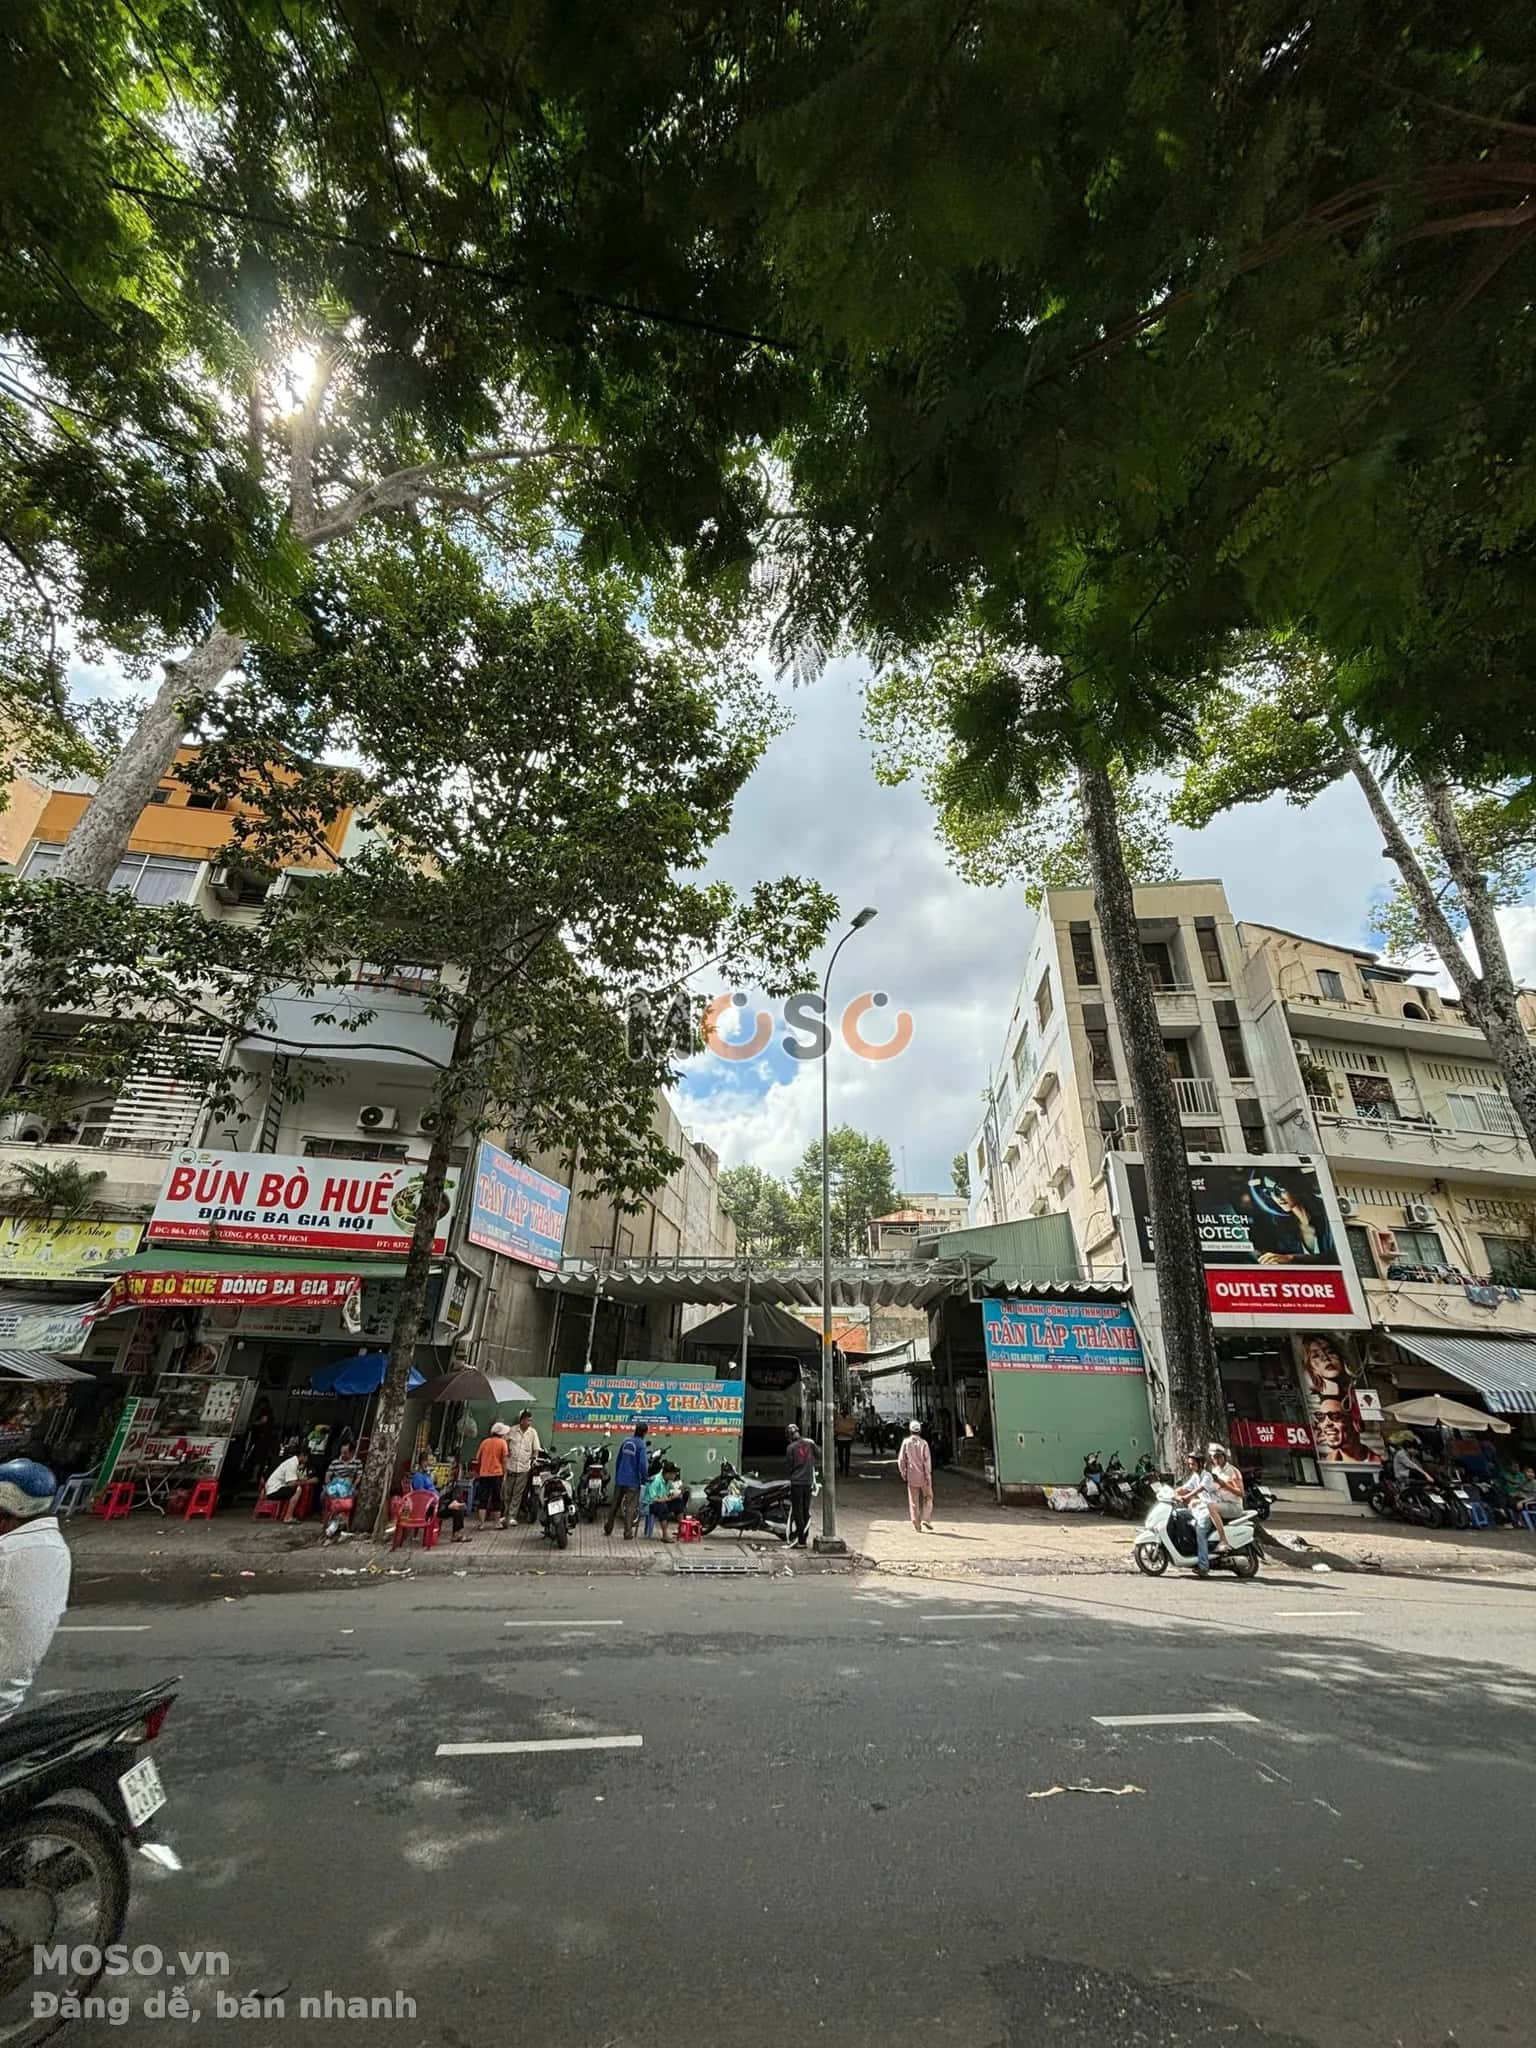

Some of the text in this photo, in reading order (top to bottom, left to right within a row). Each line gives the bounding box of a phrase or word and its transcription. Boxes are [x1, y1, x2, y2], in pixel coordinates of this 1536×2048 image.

[167, 1160, 403, 1216] BÚN BÒ HUẾ
[479, 1168, 506, 1217] TÂN
[504, 1184, 530, 1232] LẬP
[529, 1199, 564, 1241] THÀNH
[198, 1206, 374, 1231] ĐÔNG BA GIA HỘI
[1219, 1214, 1249, 1225] TECH
[151, 1275, 177, 1295] BÒ
[181, 1273, 217, 1295] HUẾ
[221, 1275, 268, 1295] ĐÔNG
[272, 1278, 295, 1295] BA
[300, 1279, 328, 1296] GIA
[1215, 1282, 1336, 1299] OUTLET STORE
[987, 1315, 1138, 1354] TÂN LẬP THÀNH
[567, 1387, 614, 1408] TÂN
[617, 1389, 661, 1413] LẬP
[666, 1391, 743, 1413] THÀNH
[1256, 1426, 1275, 1434] SALE
